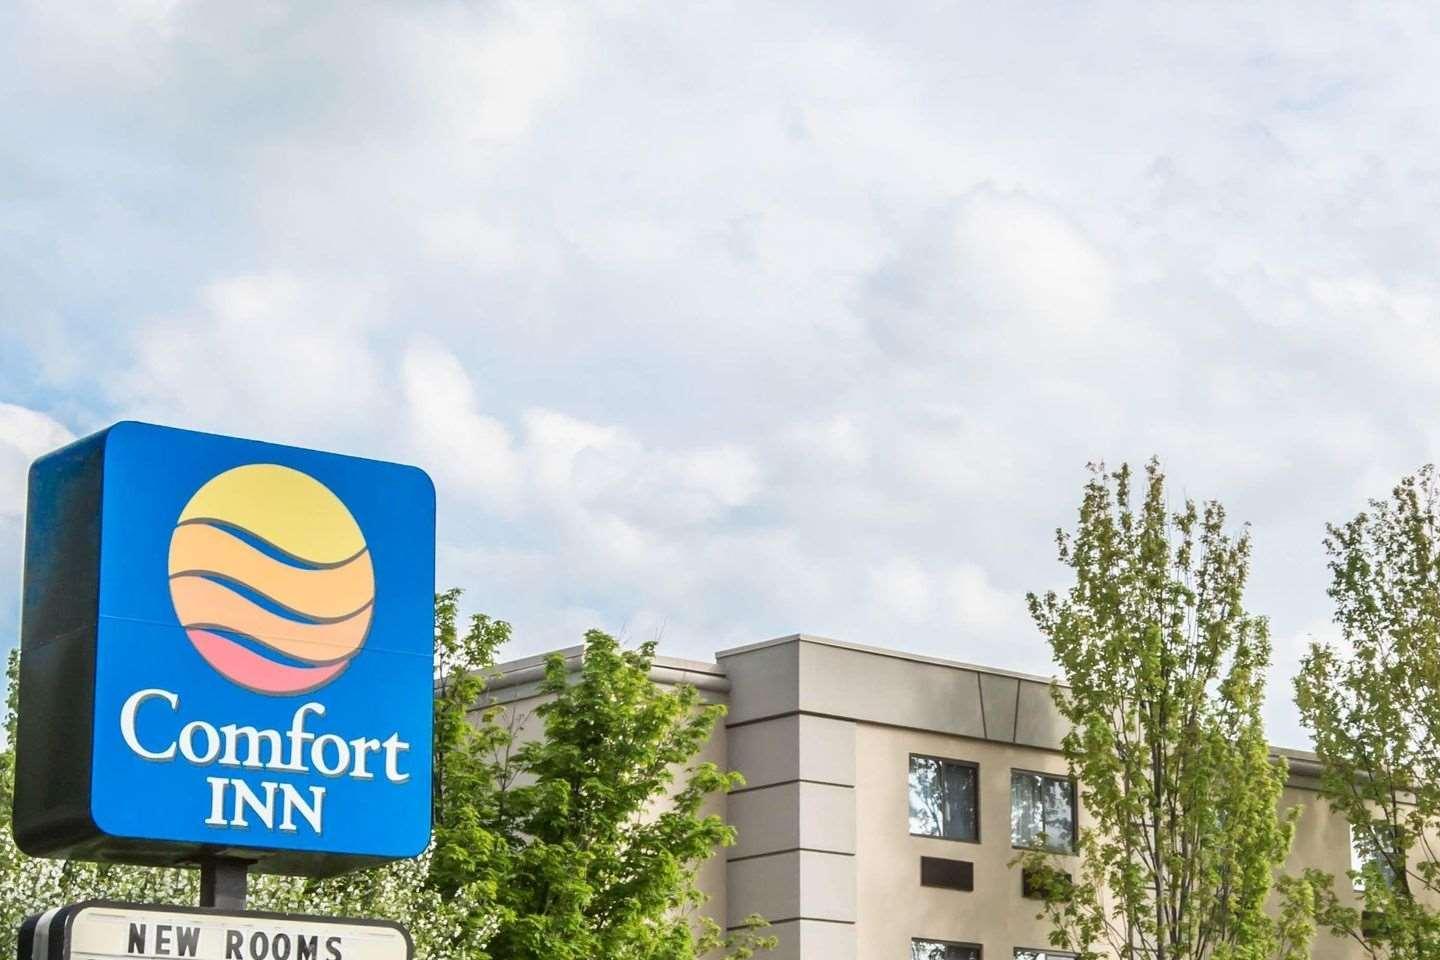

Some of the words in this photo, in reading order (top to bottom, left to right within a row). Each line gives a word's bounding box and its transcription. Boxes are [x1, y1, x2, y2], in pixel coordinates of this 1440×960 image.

[120, 688, 410, 782] Comfort
[205, 776, 327, 834] INN
[127, 923, 201, 957] NEW
